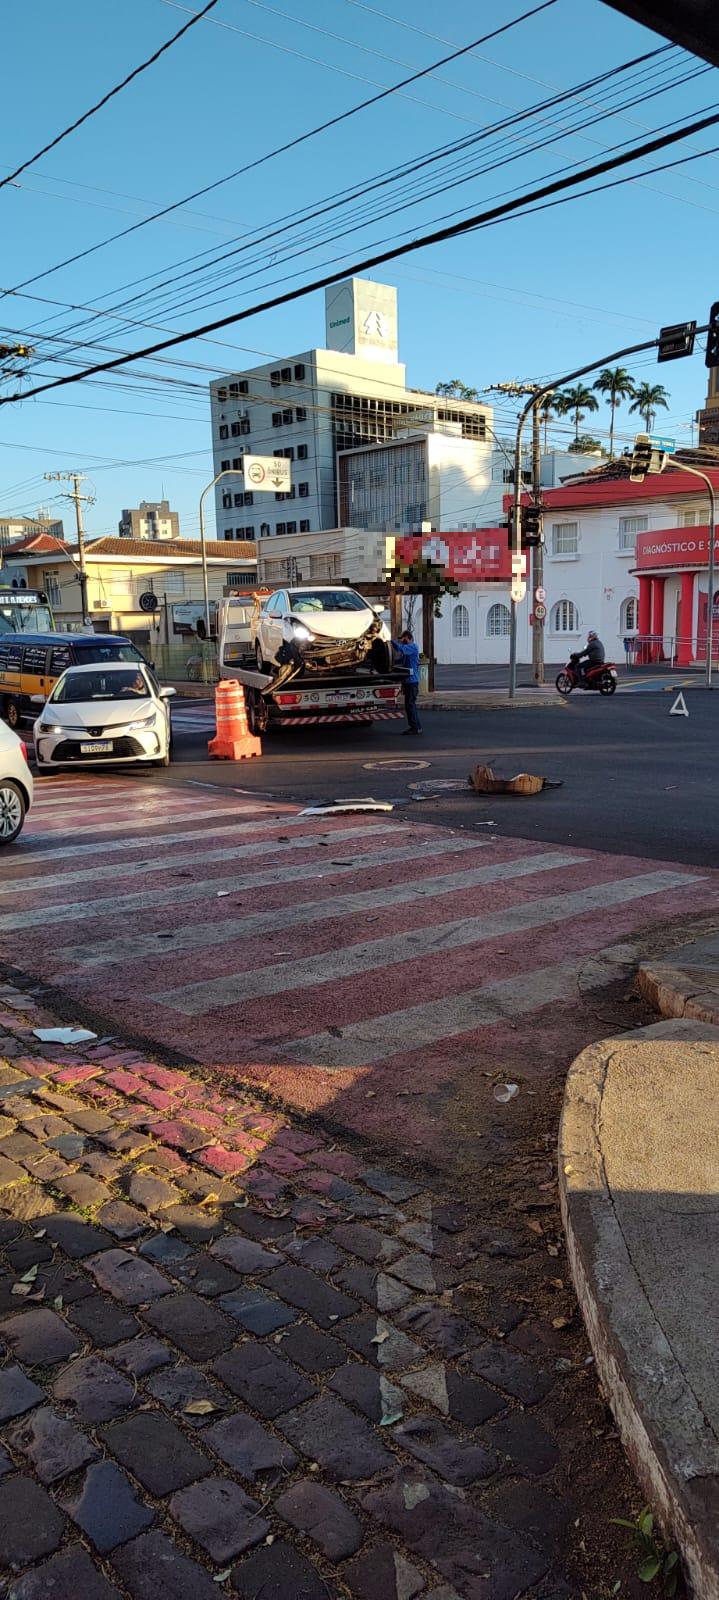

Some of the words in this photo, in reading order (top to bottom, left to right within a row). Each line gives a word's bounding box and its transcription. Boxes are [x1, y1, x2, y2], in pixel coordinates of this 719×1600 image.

[329, 316, 350, 328] Unimed
[643, 541, 696, 555] DIAGNÓSTICO
[698, 540, 705, 550] E
